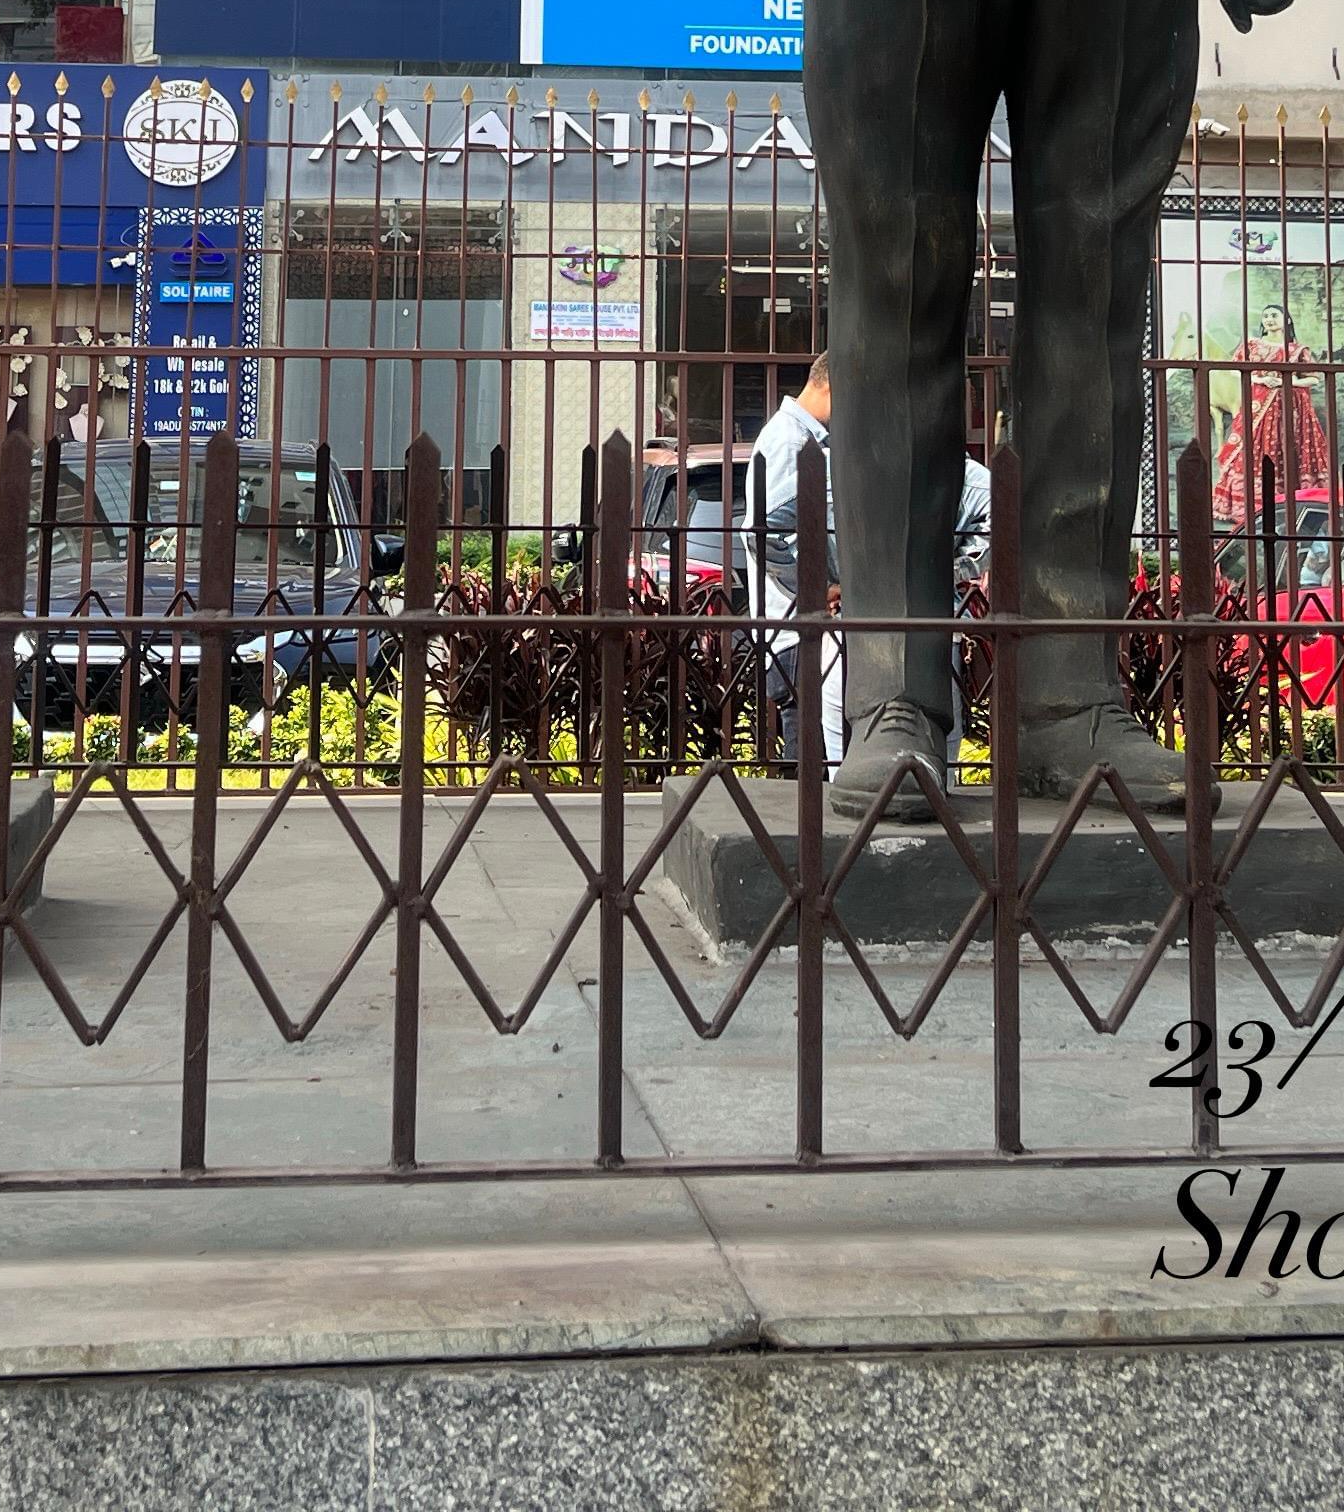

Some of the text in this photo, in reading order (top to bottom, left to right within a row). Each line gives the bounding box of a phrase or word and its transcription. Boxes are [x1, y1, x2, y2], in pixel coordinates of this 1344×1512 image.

[690, 34, 803, 55] FOUNDATI
[139, 117, 221, 146] SKJ
[162, 286, 231, 298] SOLTAIRE
[172, 335, 206, 349] Reail
[167, 356, 225, 372] Whlesale
[153, 378, 173, 394] 18k
[175, 379, 184, 394] &
[209, 379, 230, 394] Gol
